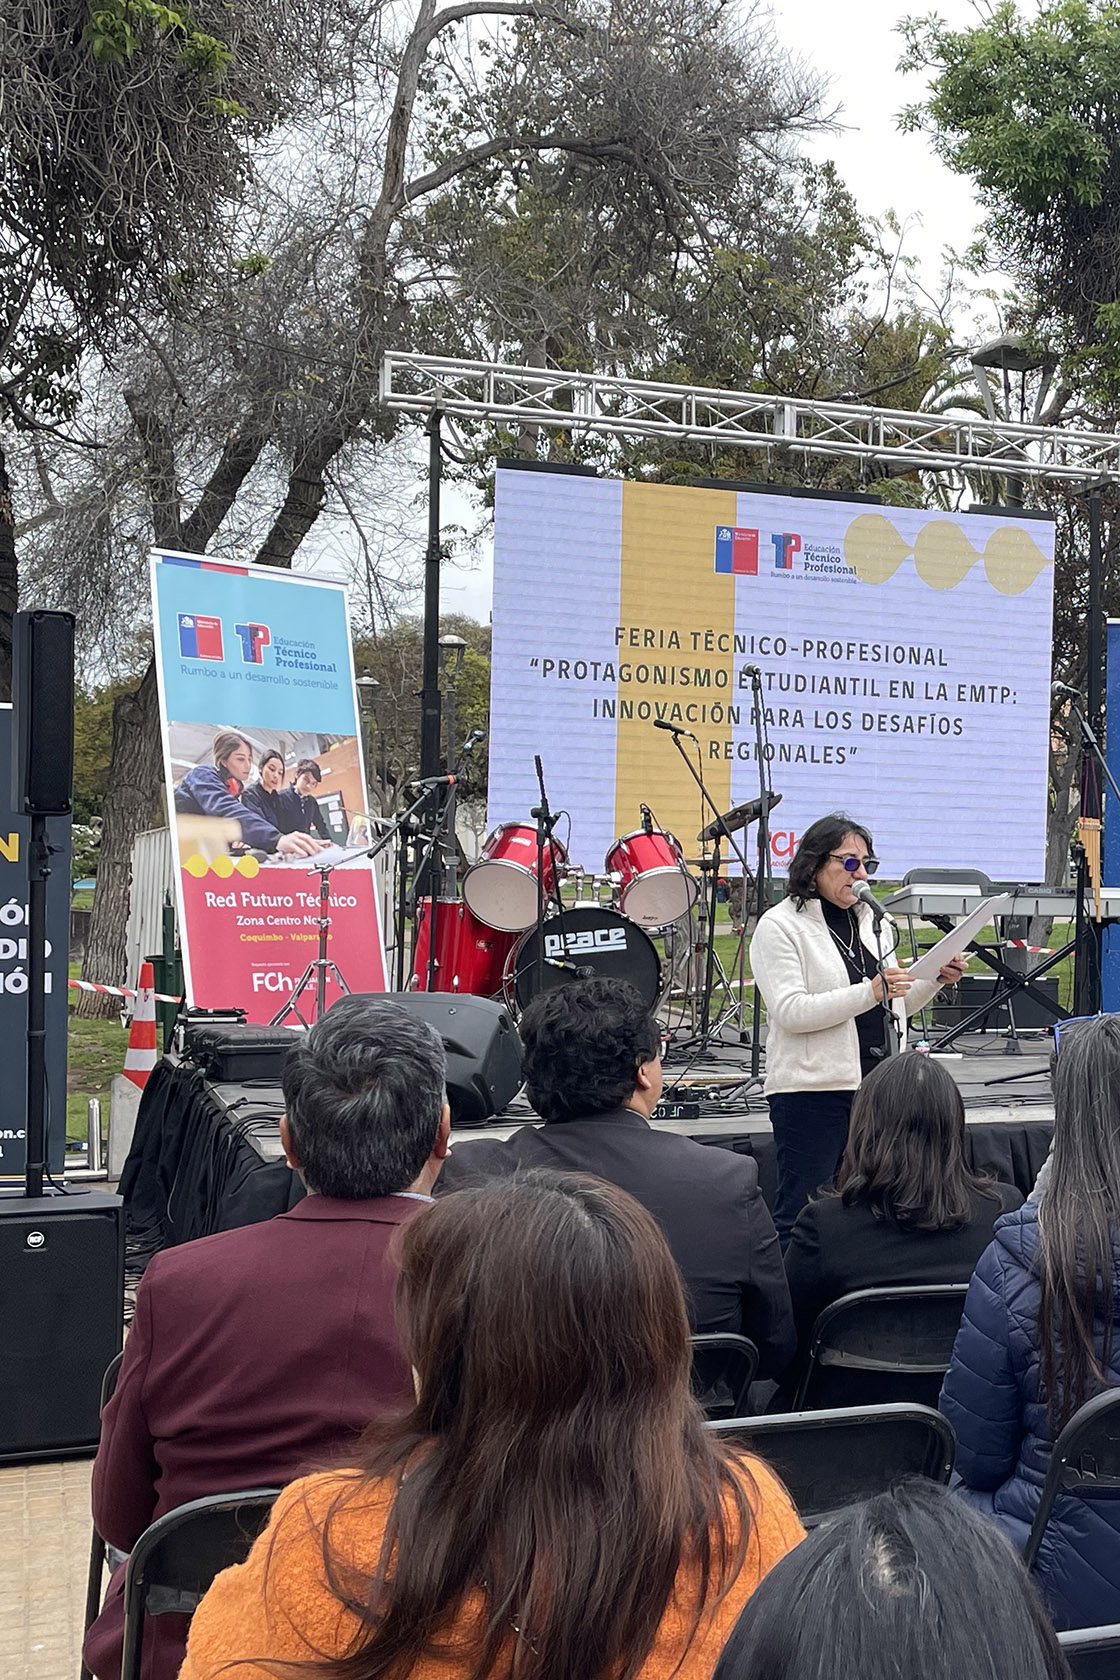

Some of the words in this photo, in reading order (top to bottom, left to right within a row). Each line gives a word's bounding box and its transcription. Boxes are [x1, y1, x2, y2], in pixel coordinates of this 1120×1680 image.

[804, 543, 841, 554] Educación
[804, 552, 841, 564] Técnico
[804, 562, 857, 575] Profesional
[771, 571, 790, 579] Rumbo
[831, 576, 857, 584] sostenible
[273, 637, 316, 650] Educación
[615, 627, 681, 649] FERIA
[690, 629, 948, 666] TÉCNICO-PROFESIONAL
[274, 646, 317, 660] Técnico
[275, 657, 337, 673] Profesional
[180, 665, 218, 678] Rumbo
[220, 671, 226, 679] a
[229, 672, 243, 681] un
[245, 671, 291, 686] desarrollo
[292, 677, 339, 691] sostenible
[739, 670, 880, 697] ETUDIANTIL
[889, 680, 915, 699] EN
[925, 682, 948, 701] LA
[957, 684, 1018, 705] EMTP:
[593, 698, 740, 725] INNOVACIÓN
[750, 706, 805, 728] PARA
[814, 711, 852, 730] LOS
[862, 713, 963, 736] DESAFÍOS
[205, 892, 237, 907] Red
[240, 892, 293, 907] Futuro
[236, 915, 264, 926] Zona
[266, 915, 301, 926] Centro
[240, 933, 283, 943] Coquimbo
[252, 972, 293, 992] FCh
